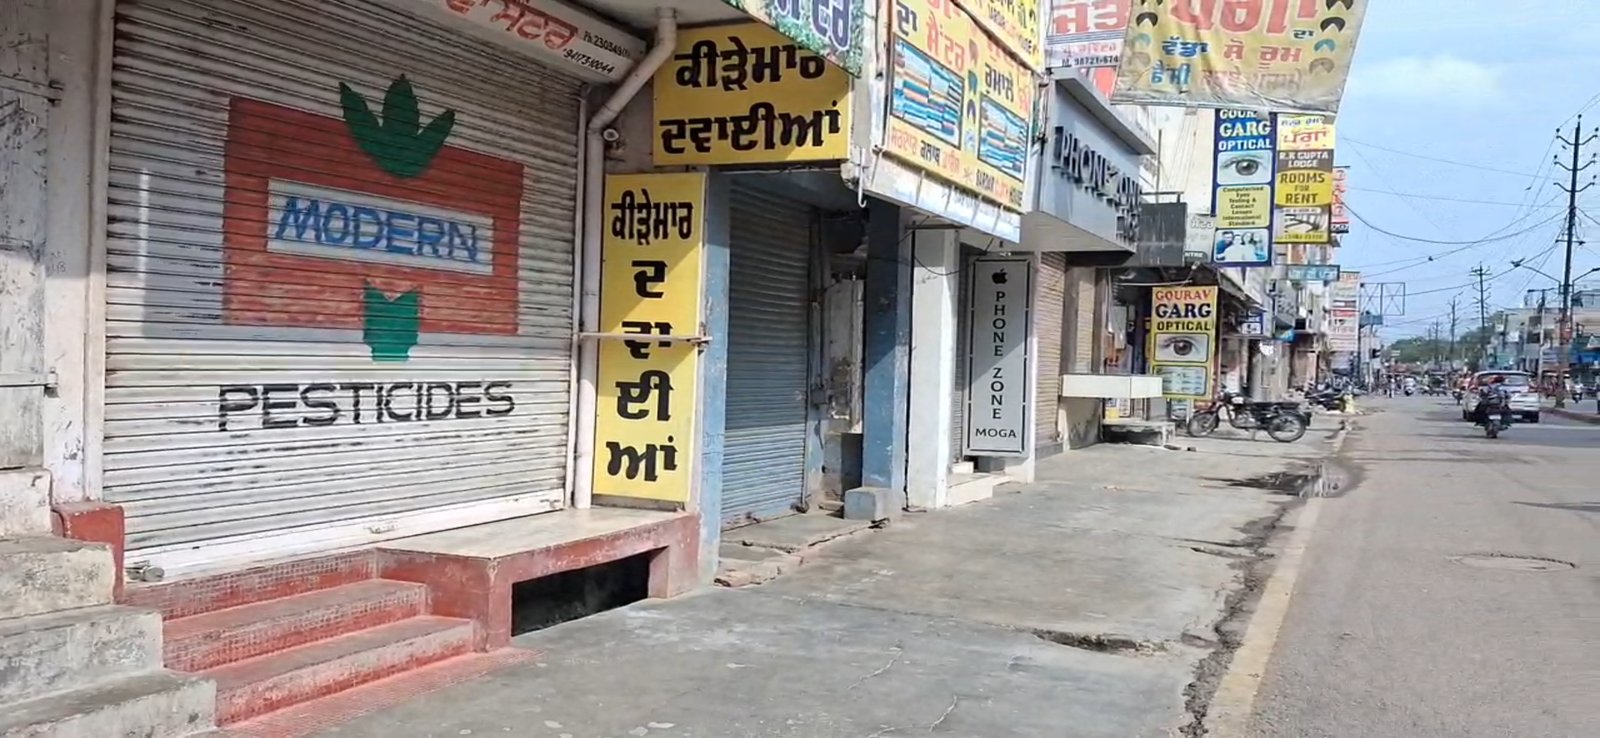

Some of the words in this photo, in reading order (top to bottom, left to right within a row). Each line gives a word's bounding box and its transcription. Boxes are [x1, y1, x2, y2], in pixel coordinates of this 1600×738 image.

[659, 100, 842, 154] ਦਵਾਈਆਂ
[1219, 120, 1272, 137] GARG
[1218, 138, 1272, 151] OPTICAL
[1297, 151, 1329, 159] GUPTA
[1280, 172, 1325, 184] ROOMS
[1285, 193, 1318, 204] RENT
[611, 188, 693, 245] ਕੀੜੇਮਾਰ
[274, 196, 479, 264] MODERN
[1155, 290, 1211, 300] GOURAV
[1155, 303, 1211, 318] GARG
[992, 291, 1007, 357] PHONE
[1156, 321, 1211, 331] OPTICAL
[990, 367, 1005, 420] ZONE
[218, 381, 515, 431] PESTICIDES
[975, 428, 1017, 439] MOGA
